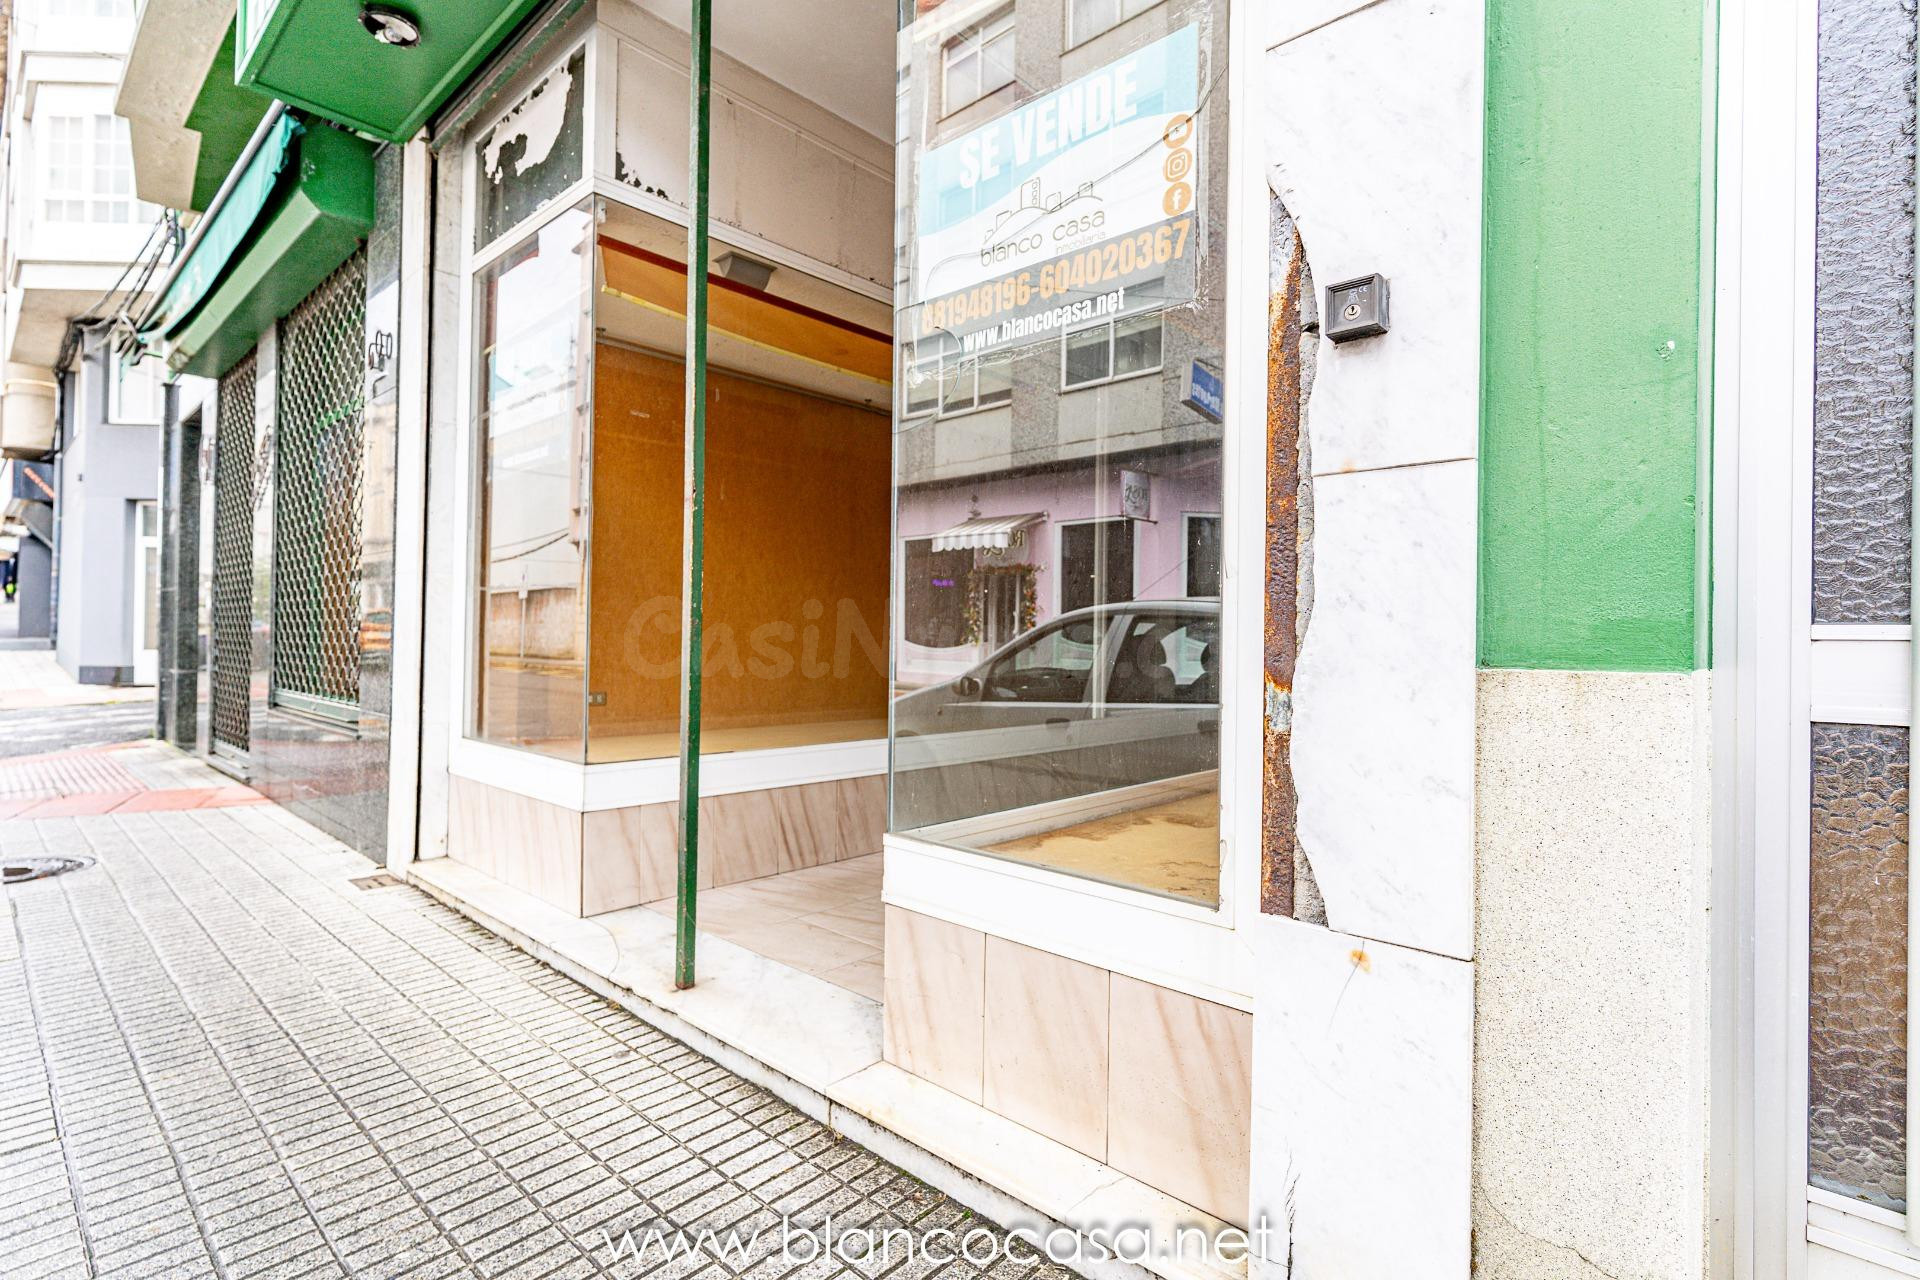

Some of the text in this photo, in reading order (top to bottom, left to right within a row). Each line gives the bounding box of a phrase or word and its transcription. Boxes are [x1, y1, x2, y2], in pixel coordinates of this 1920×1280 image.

[959, 61, 1138, 189] SE VENDE
[981, 210, 1105, 267] blanco casa
[963, 286, 1125, 352] www.blancocasa.net
